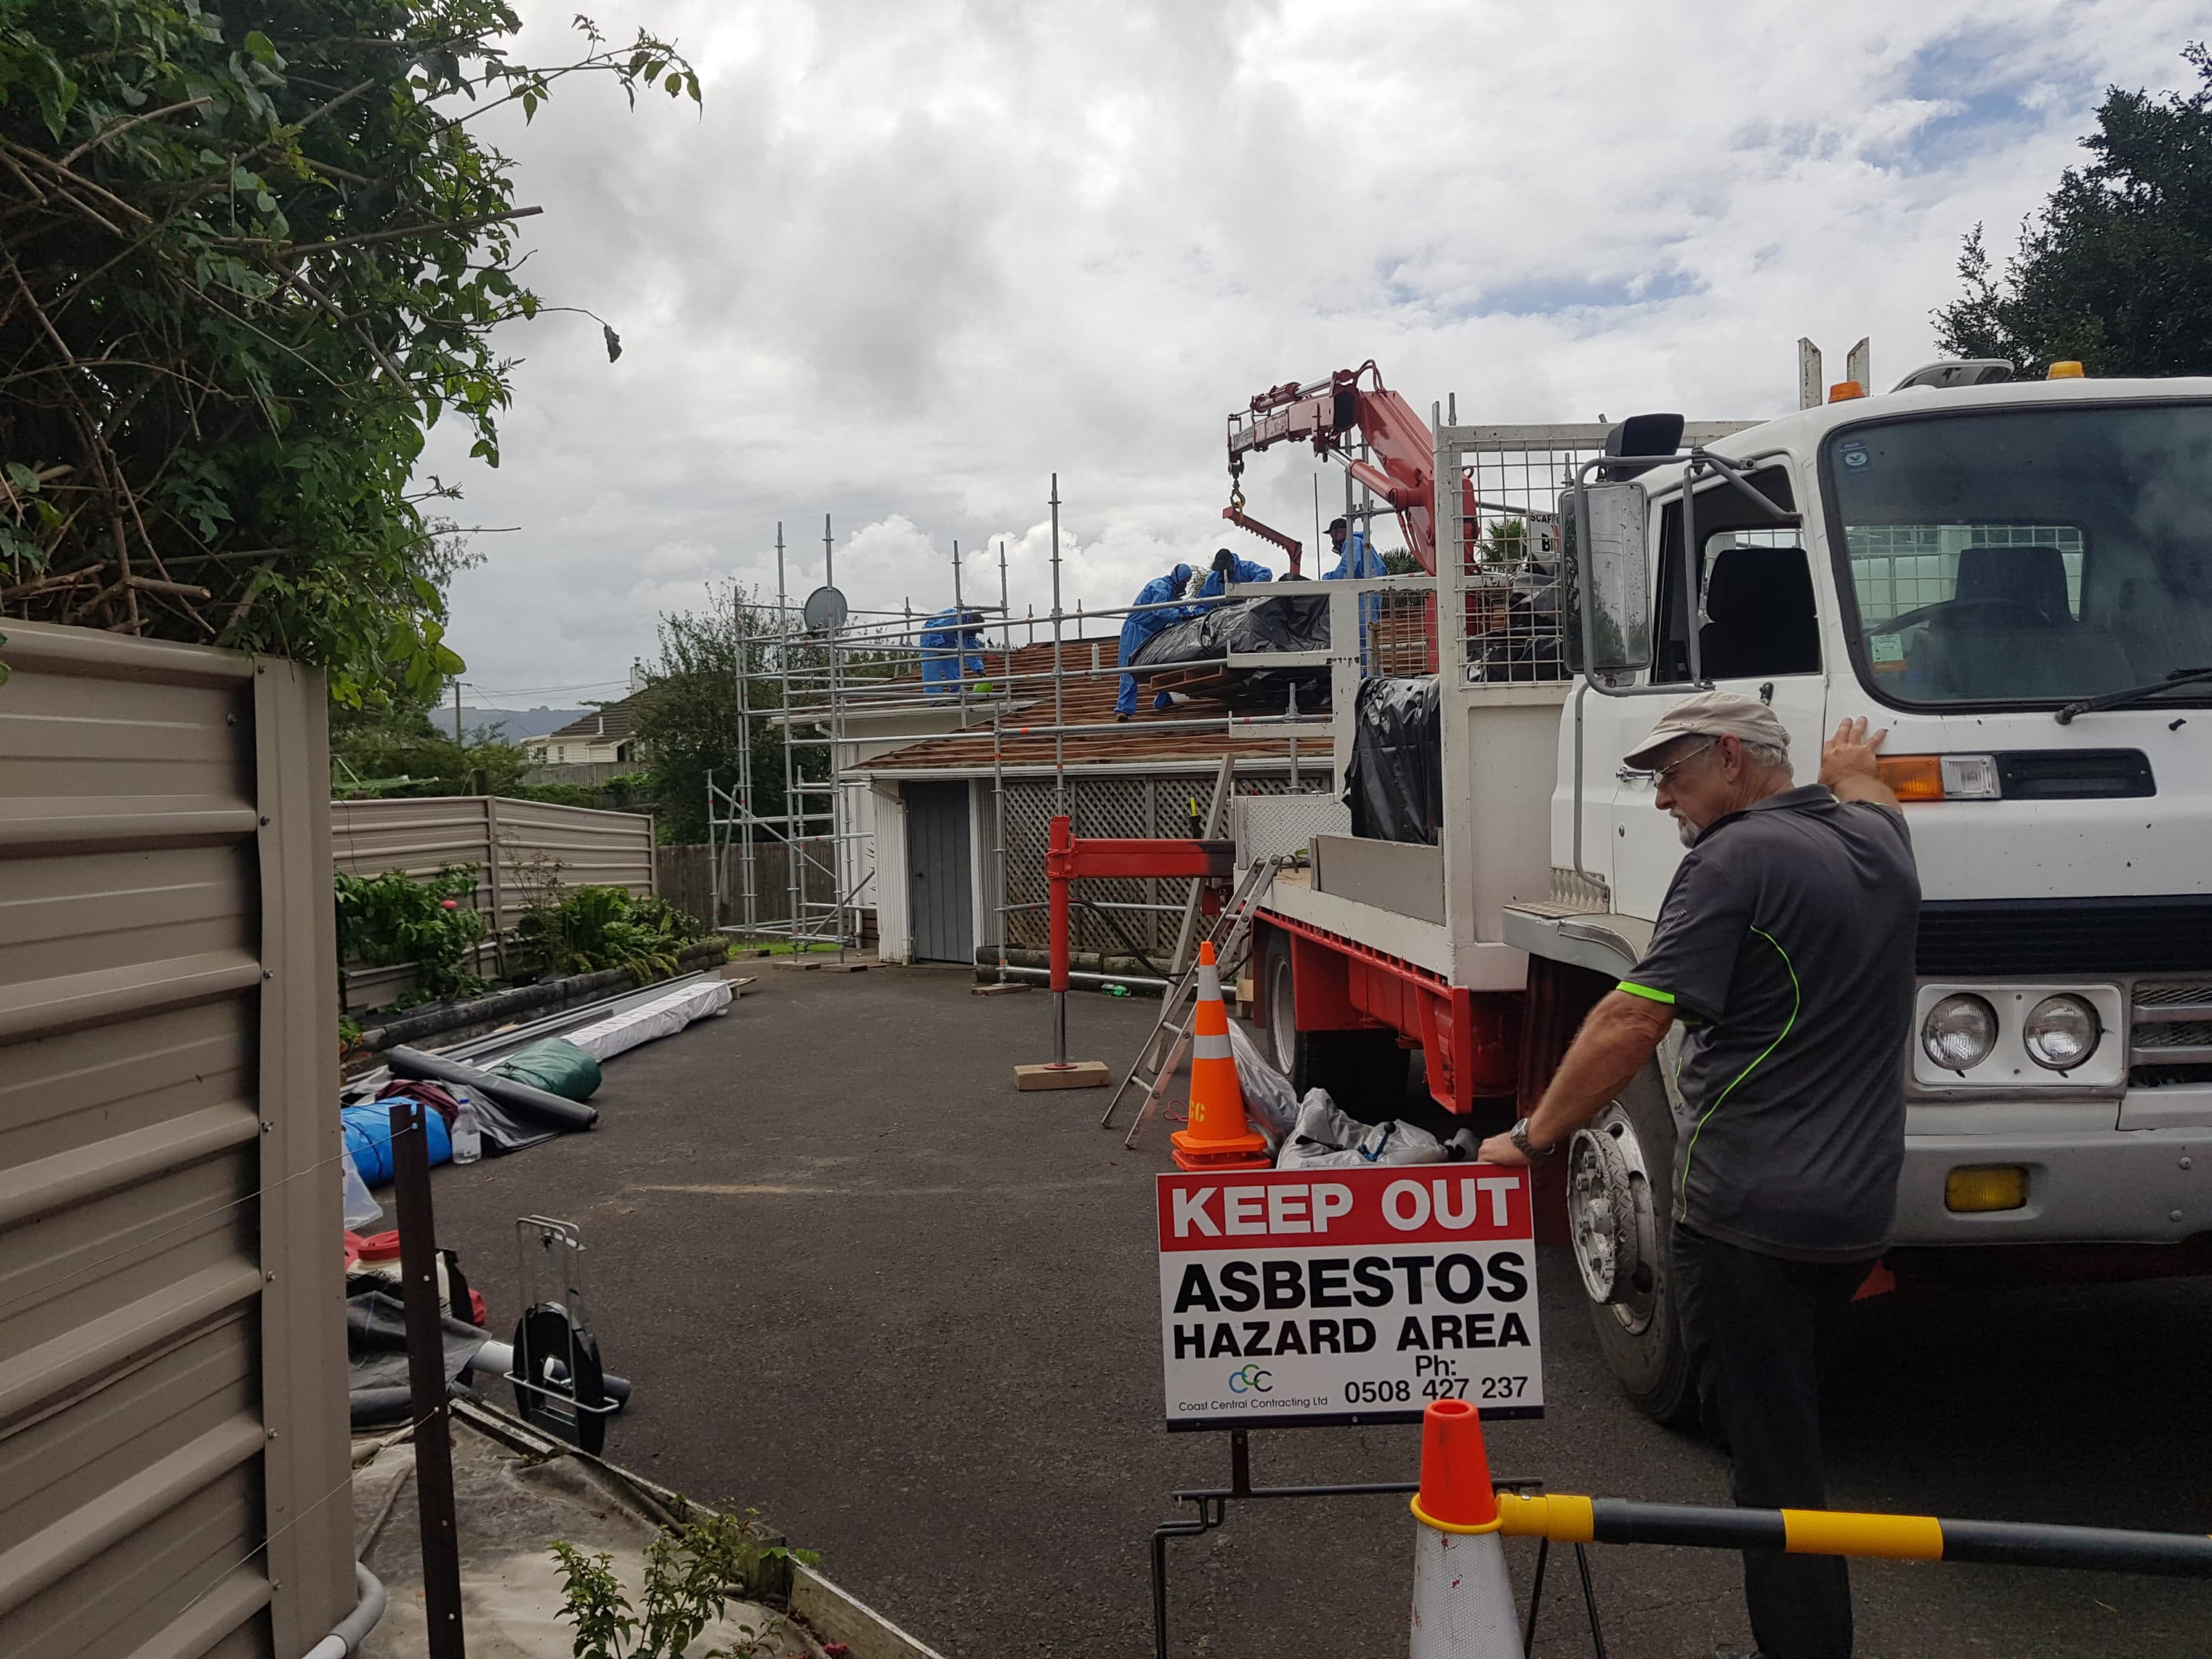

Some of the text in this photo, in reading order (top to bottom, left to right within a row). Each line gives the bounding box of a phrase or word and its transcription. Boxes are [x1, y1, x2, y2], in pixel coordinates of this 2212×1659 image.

[1172, 1177, 1520, 1237] KEEP OUT
[1173, 1251, 1528, 1314] ASBESTOS
[1173, 1312, 1531, 1360] HAZARD AREA
[1415, 1354, 1456, 1378] Ph:
[1178, 1396, 1328, 1412] Coast Central Contracting Ltd
[1344, 1376, 1528, 1404] 0508 427 237
